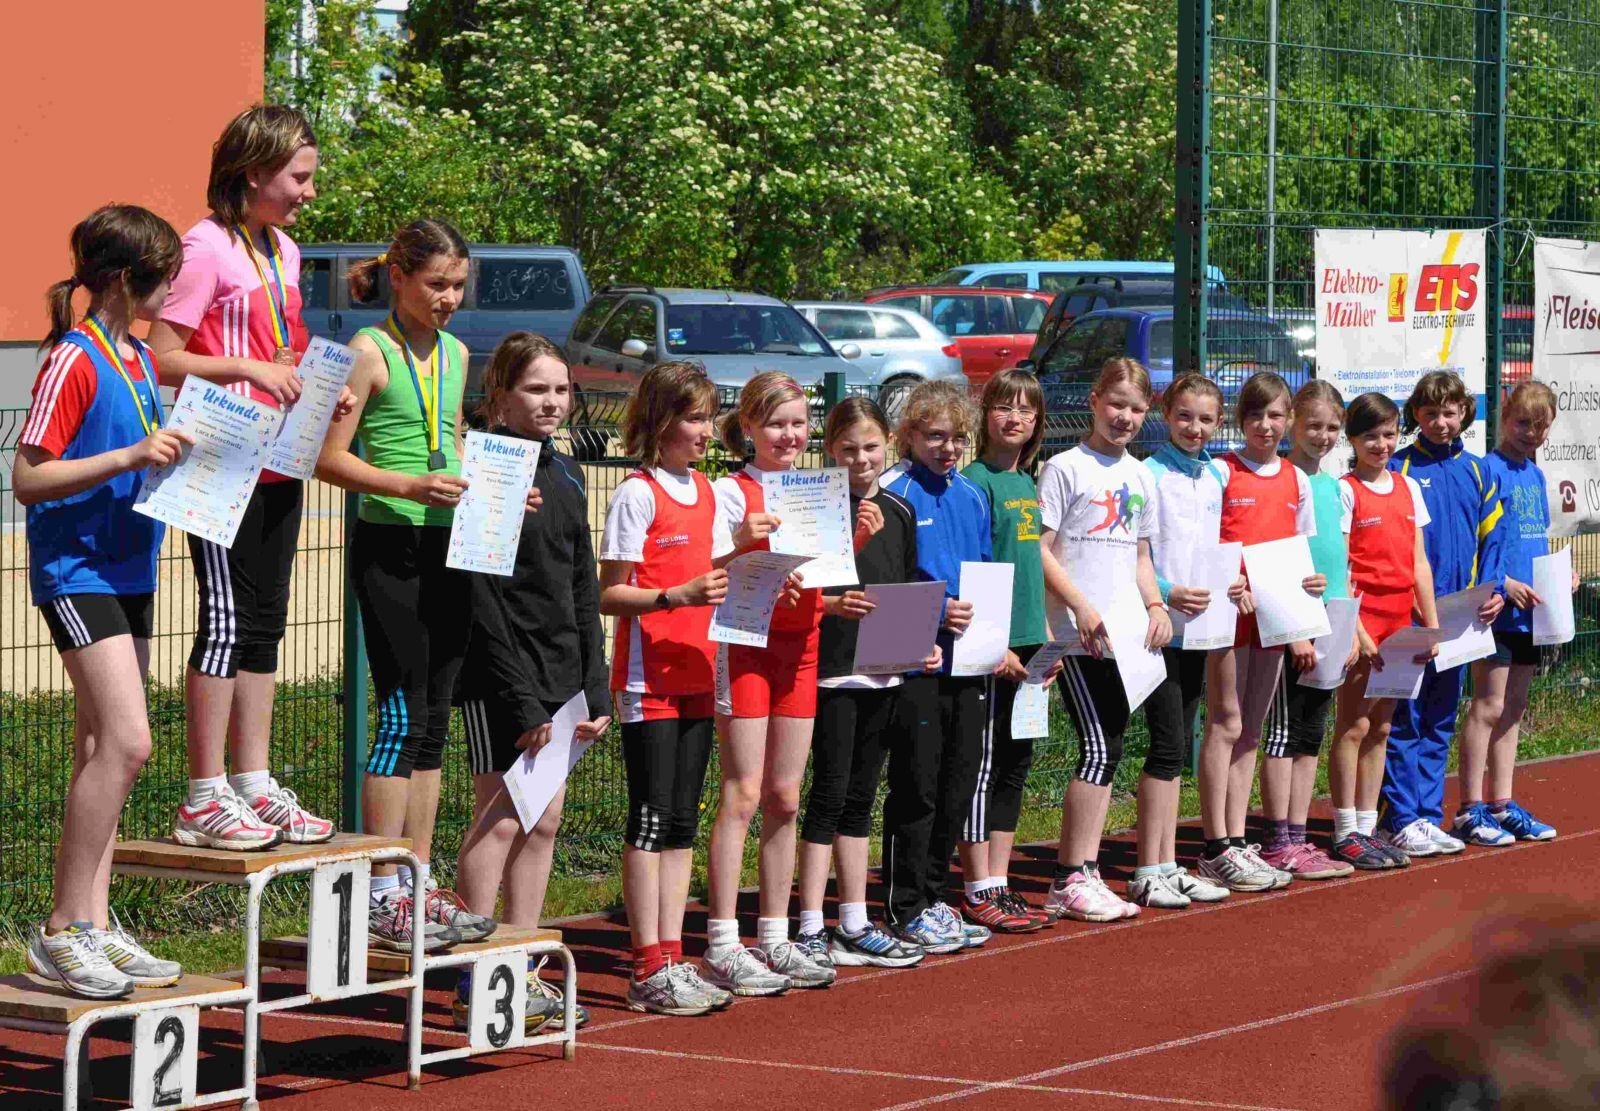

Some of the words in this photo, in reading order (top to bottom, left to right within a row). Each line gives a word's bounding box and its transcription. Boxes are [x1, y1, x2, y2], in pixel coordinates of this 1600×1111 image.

[1321, 268, 1384, 295] Elektro-
[1414, 262, 1480, 312] ETS
[1324, 302, 1377, 328] Müller
[203, 387, 260, 422] Urkunde
[483, 438, 526, 458] Urkunde
[1543, 438, 1597, 461] Bautzener
[781, 472, 831, 487] Urkunde
[331, 872, 353, 987] 1
[486, 964, 515, 1048] 3
[152, 1016, 185, 1106] 2
